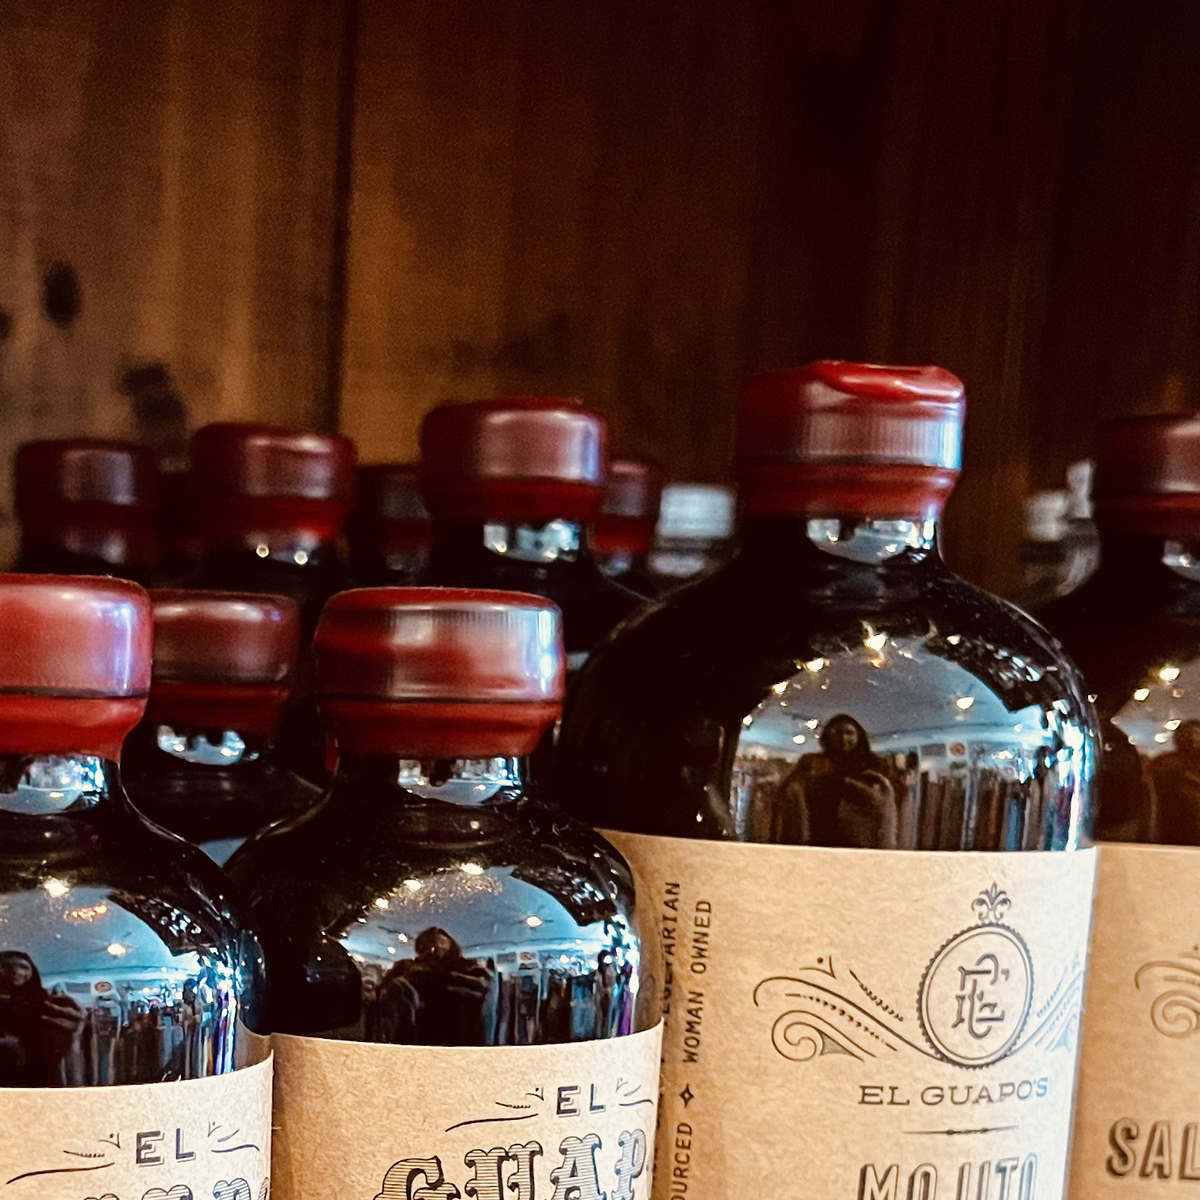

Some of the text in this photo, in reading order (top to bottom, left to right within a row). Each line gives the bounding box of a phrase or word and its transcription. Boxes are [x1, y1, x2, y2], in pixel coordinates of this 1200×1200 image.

[690, 901, 712, 975] OWNED
[683, 989, 704, 1064] WOMAN
[555, 1083, 607, 1117] EL
[858, 1077, 1048, 1106] EL GUAPO'S
[134, 1126, 197, 1166] EL
